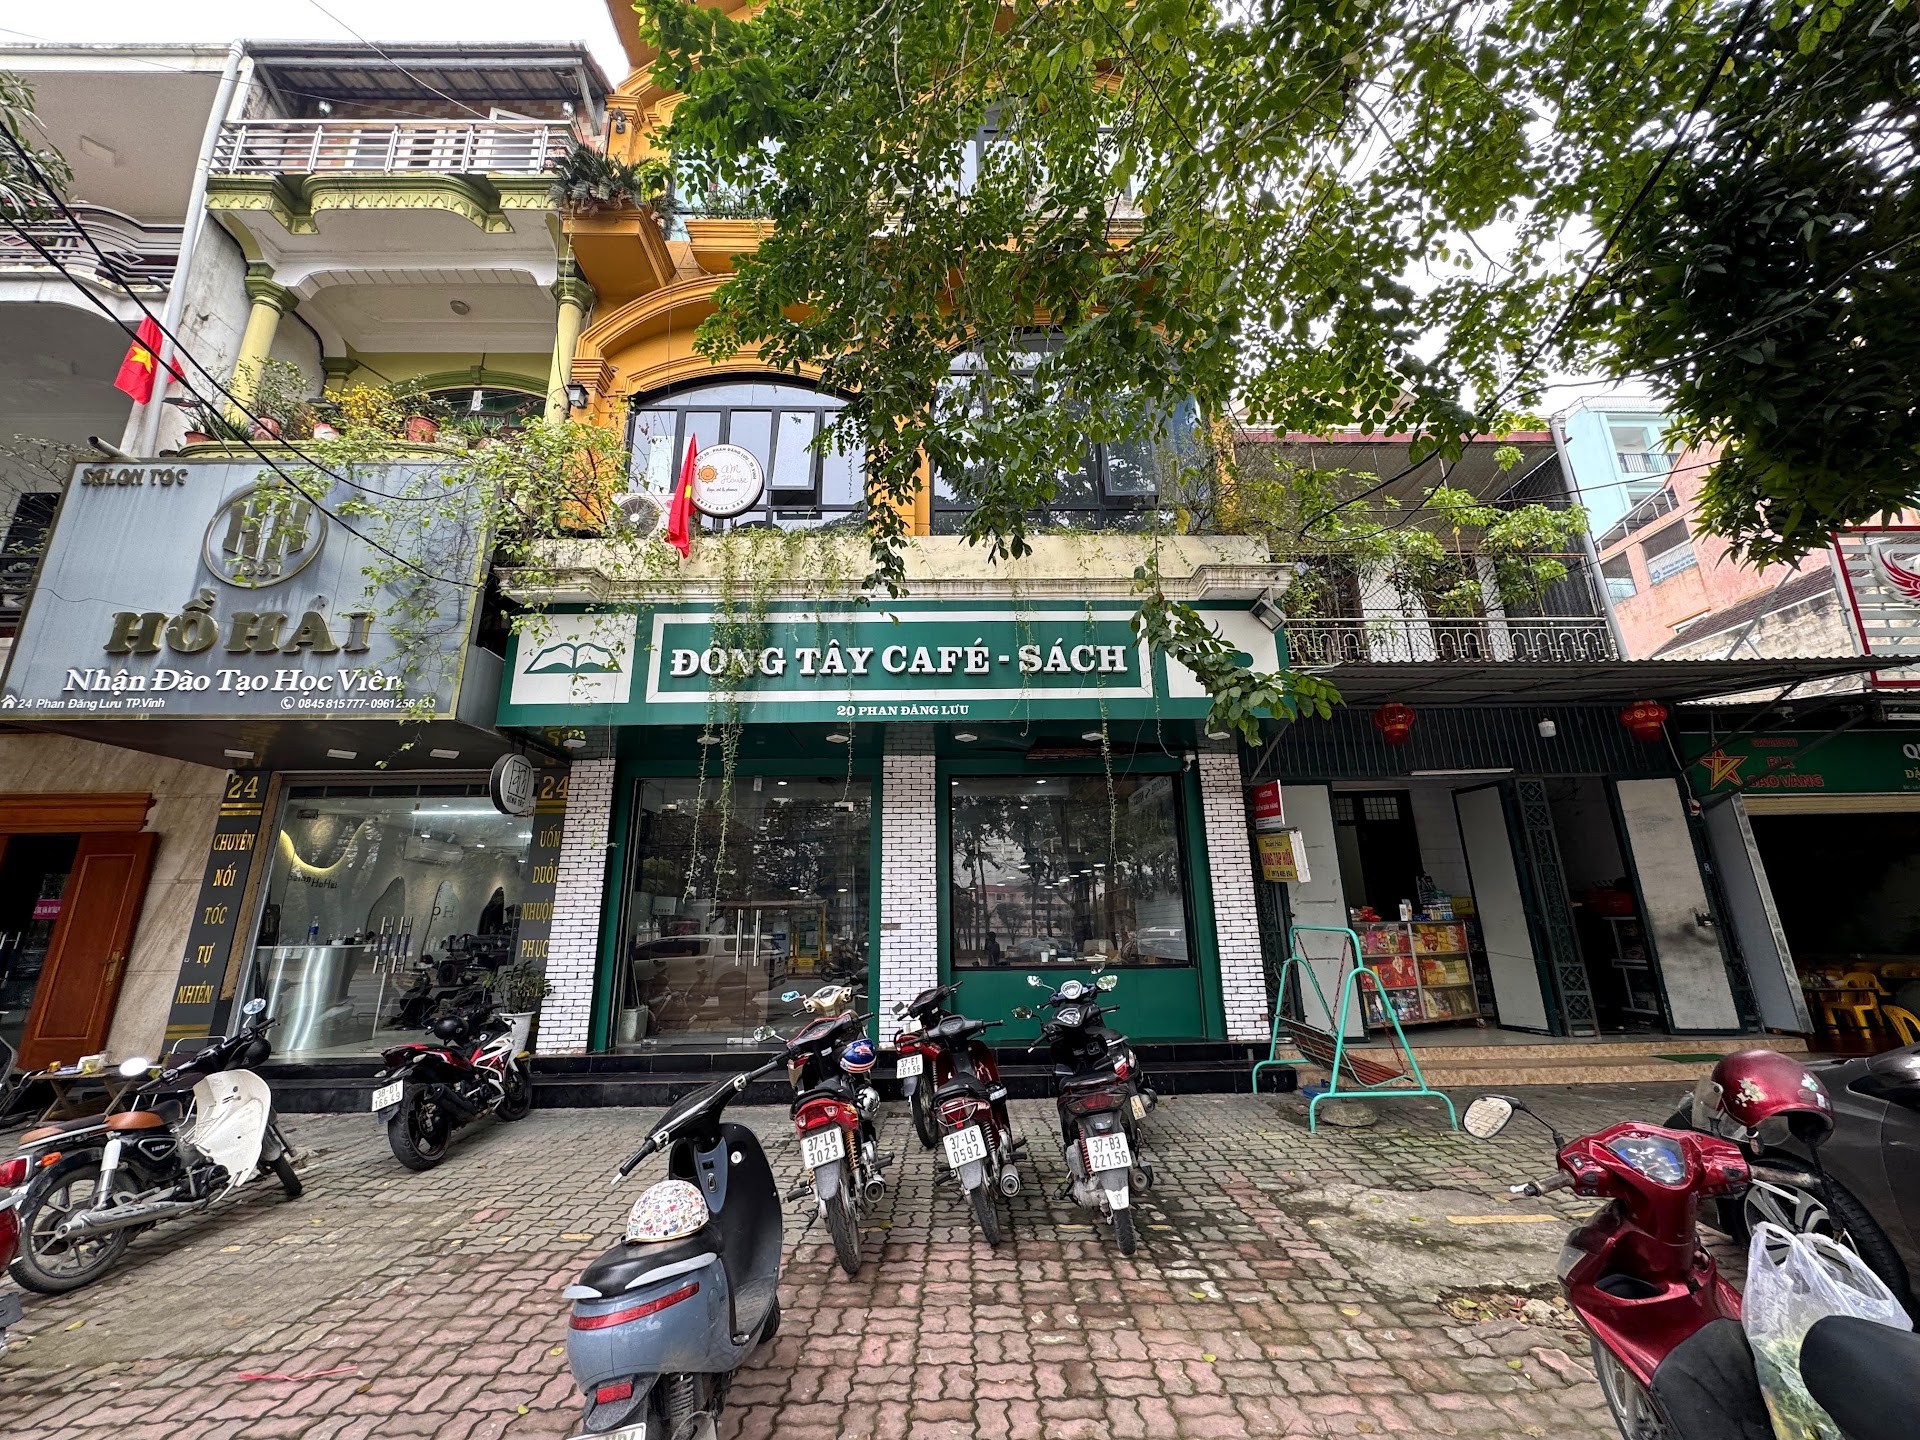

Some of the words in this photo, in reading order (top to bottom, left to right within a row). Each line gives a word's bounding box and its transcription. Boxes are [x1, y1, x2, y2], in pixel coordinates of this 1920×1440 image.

[150, 466, 188, 486] TÓC
[670, 640, 787, 676] ĐÔNG
[796, 638, 874, 675] TÂY
[881, 637, 990, 674] CAFÉ
[1018, 637, 1129, 674] SÁCH
[62, 668, 146, 696] Nhận
[150, 669, 211, 692] Đào
[216, 669, 268, 697] Tạo
[271, 669, 333, 696] Học
[17, 698, 32, 709] 24
[36, 698, 65, 709] Phan
[67, 698, 97, 711] Đăng
[99, 698, 121, 709] Lưu
[126, 697, 165, 709] TP.Vinh
[837, 705, 856, 717] 20
[858, 706, 899, 716] PHAN
[900, 704, 940, 716] ĐĂNG
[941, 704, 970, 716] LƯU
[227, 775, 259, 799] 24
[540, 775, 570, 799] 24
[213, 828, 256, 851] CHUYÊN
[540, 824, 561, 848] UỐN
[212, 861, 238, 887] NỐI
[203, 902, 228, 925] TÓC
[196, 942, 216, 968] TỰ
[520, 939, 549, 962] PHỤC
[175, 982, 215, 1004] NHIÊN
[807, 1131, 836, 1152] 37-L8
[950, 1130, 977, 1150] 37-L6
[1093, 1136, 1121, 1153] 37-B3
[809, 1145, 838, 1166] 3023
[953, 1144, 981, 1164] 0592
[1093, 1150, 1128, 1169] 221.56
